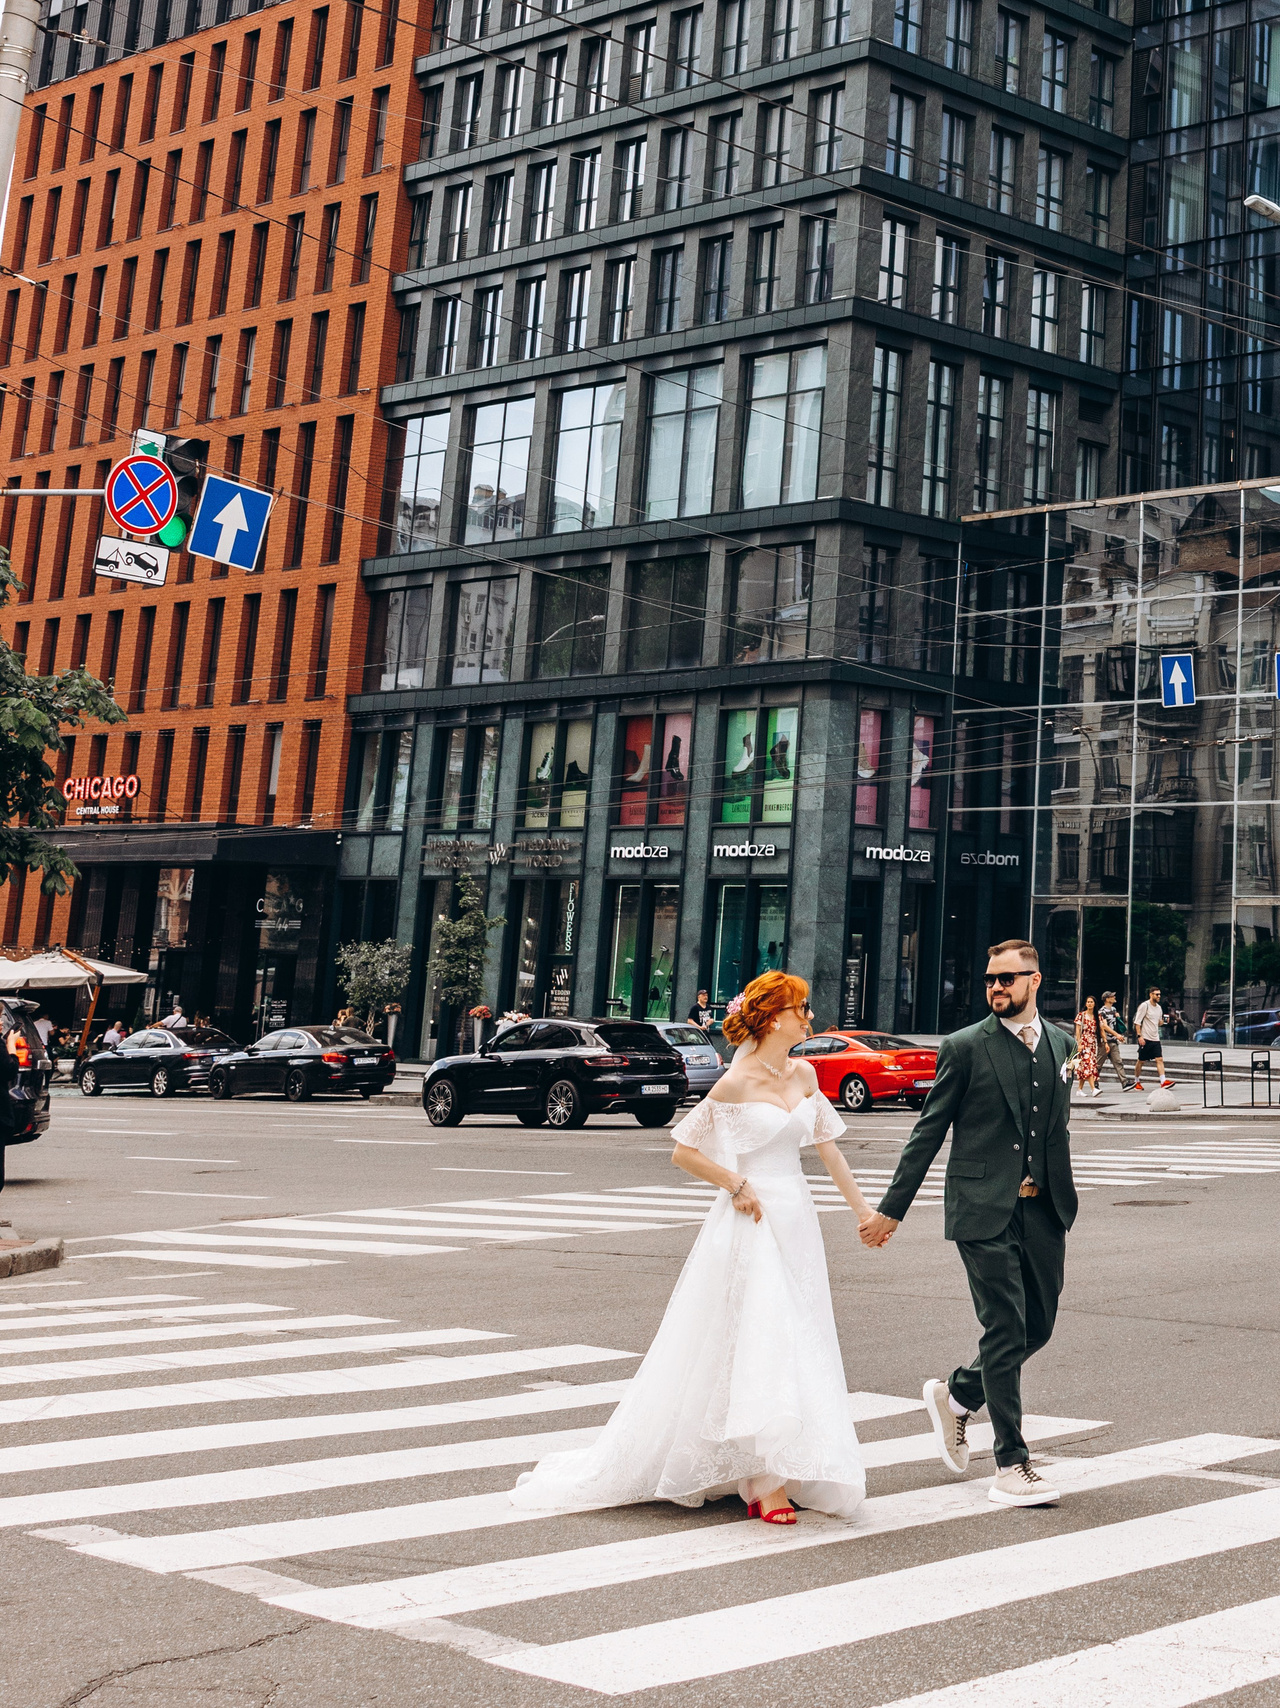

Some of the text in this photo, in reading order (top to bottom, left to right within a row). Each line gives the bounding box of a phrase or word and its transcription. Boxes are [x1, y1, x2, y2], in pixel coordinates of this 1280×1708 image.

[63, 774, 140, 800] CHICAGO
[76, 805, 120, 815] CENTRAL HOUSE
[430, 840, 475, 852] WEDDING
[519, 838, 570, 851] WEDDING
[610, 842, 669, 858] modoza
[713, 840, 775, 857] modoza
[525, 854, 563, 867] WORLD
[865, 845, 931, 863] modoza
[434, 856, 470, 868] WORLD
[565, 882, 575, 951] FLOWERS
